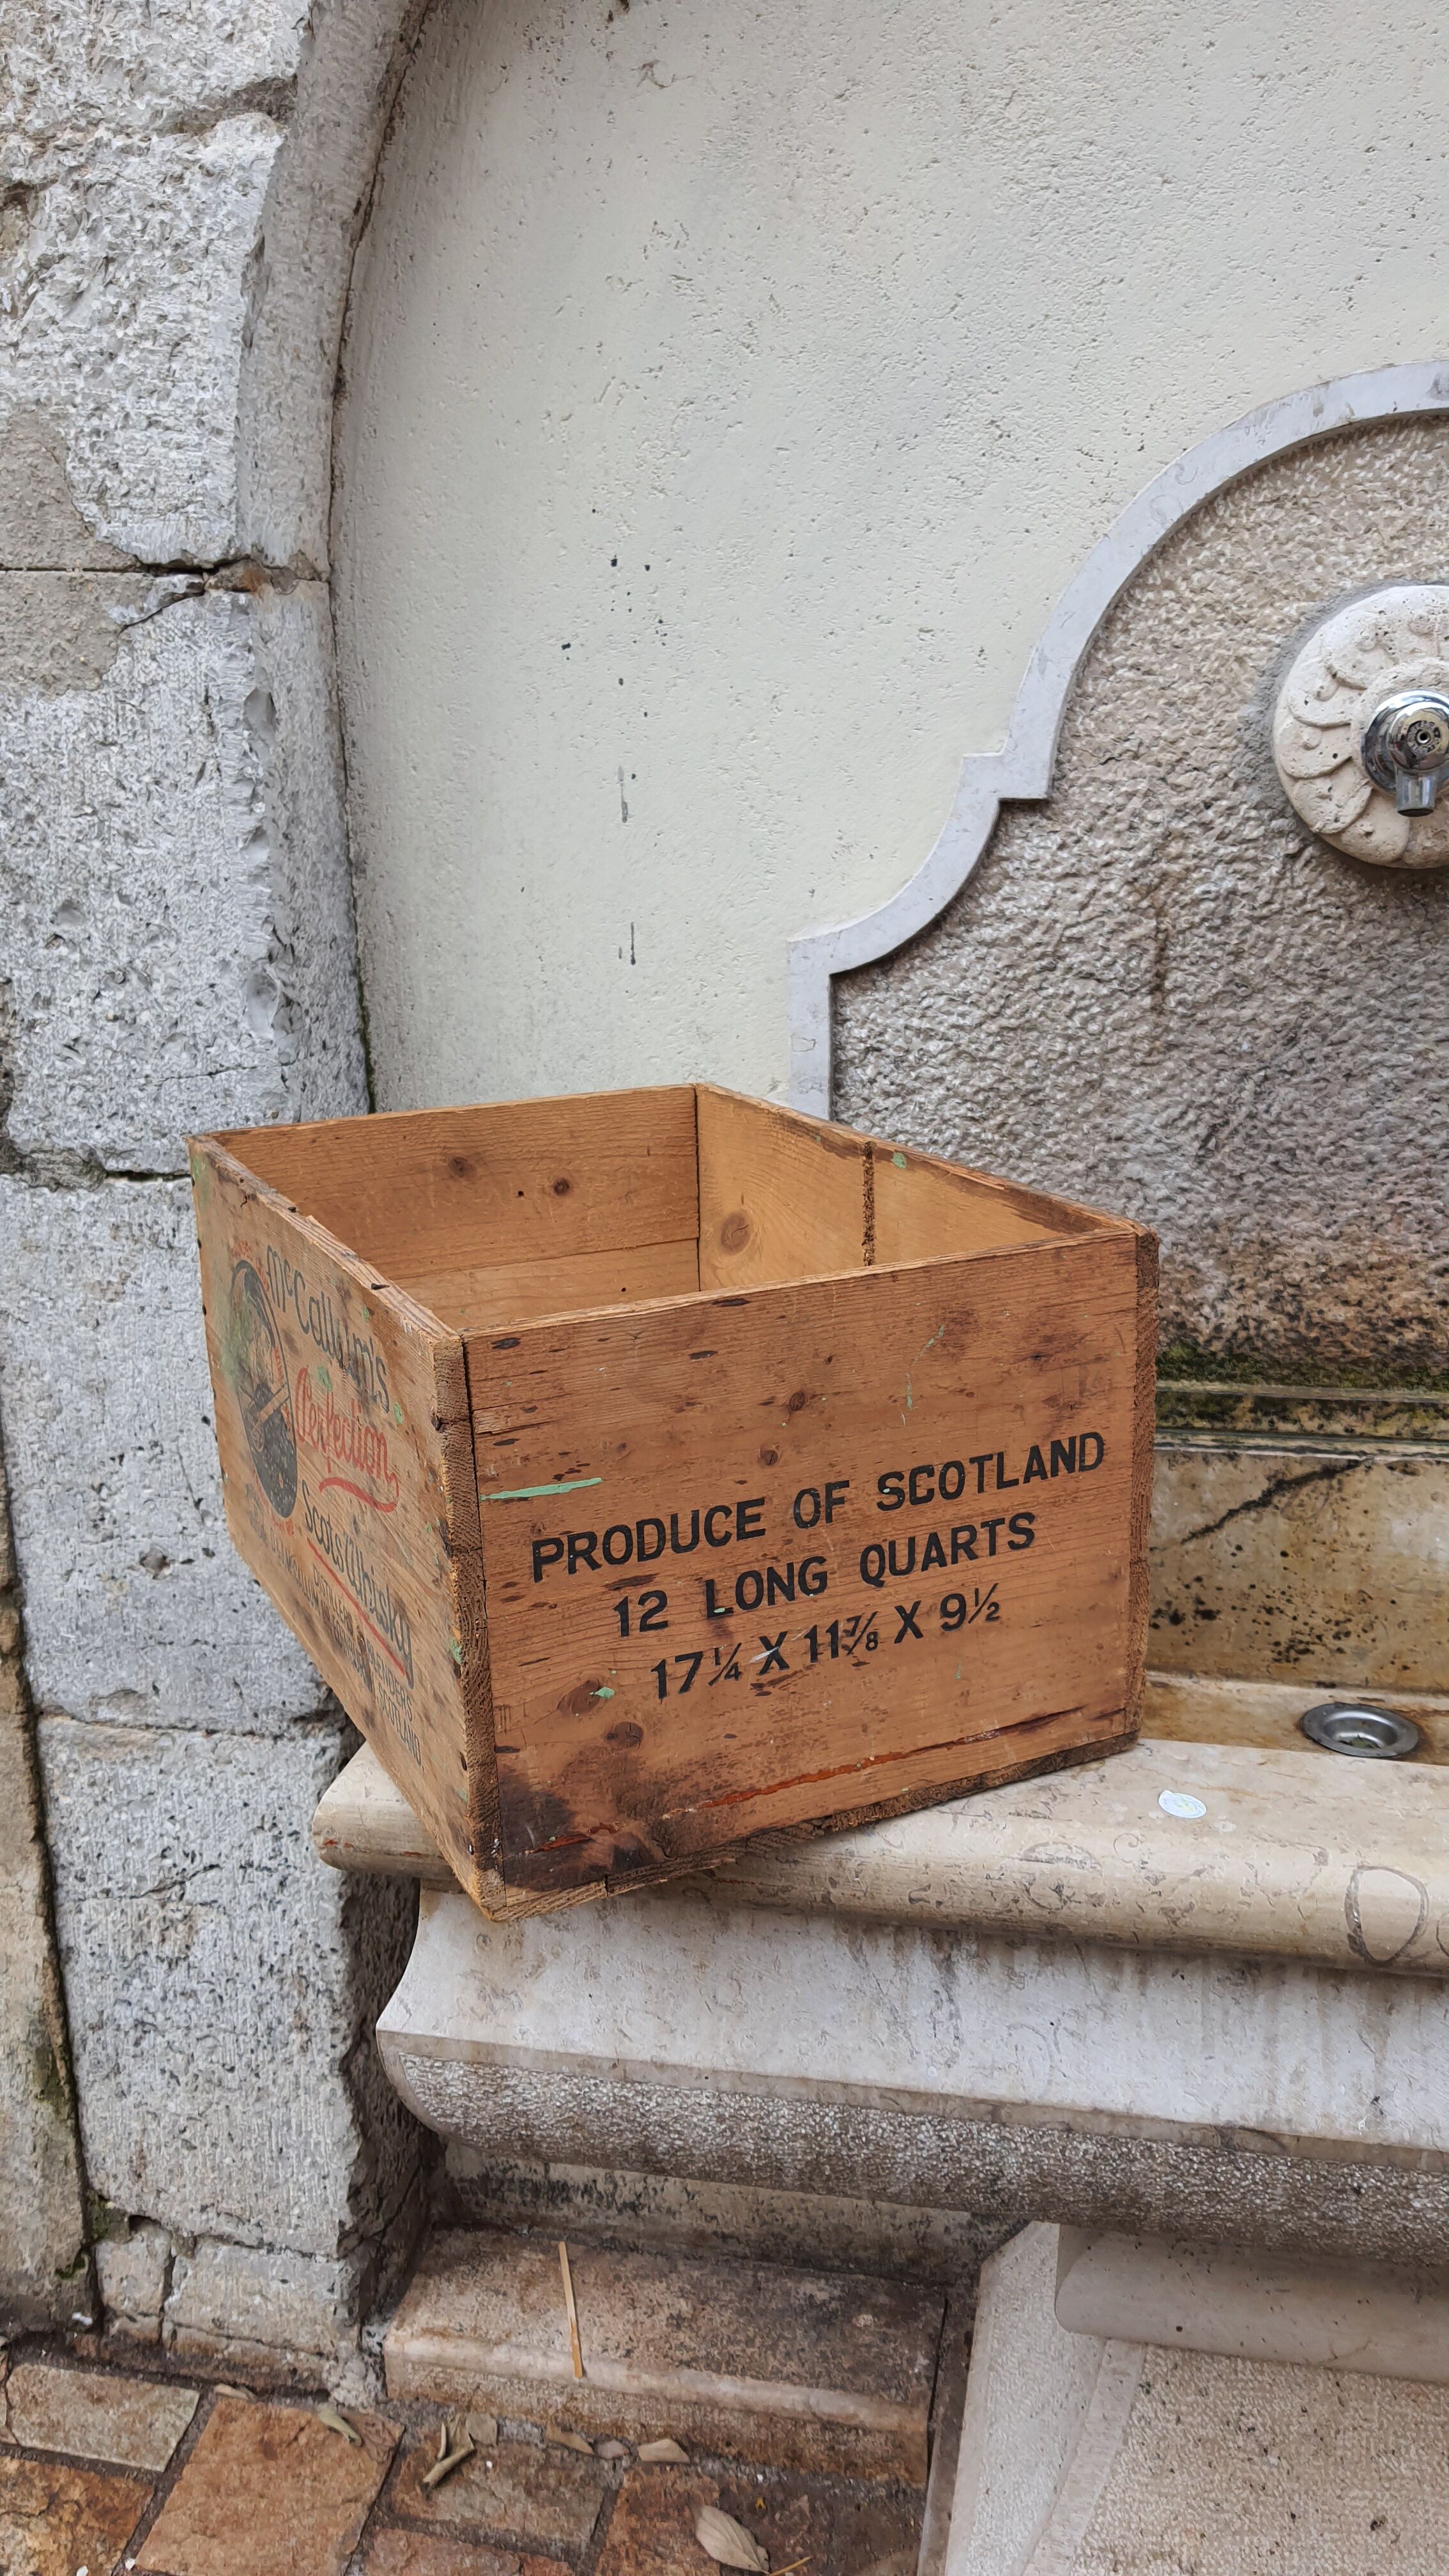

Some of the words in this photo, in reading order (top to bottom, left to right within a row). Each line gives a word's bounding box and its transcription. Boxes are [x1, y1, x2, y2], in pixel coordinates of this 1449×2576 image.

[295, 1366, 399, 1495] Perfection
[532, 1496, 766, 1584] PRODUCE
[793, 1480, 850, 1529] OF
[876, 1431, 1104, 1512] SCOTLAND
[613, 1590, 669, 1637] 12
[705, 1556, 828, 1620] LONG
[859, 1512, 1036, 1588] QUARTS
[302, 1478, 344, 1573] Scots
[344, 1531, 414, 1689] Whisky
[313, 1563, 353, 1637] DISTILLERS
[366, 1639, 413, 1722] BLENDERS
[894, 1600, 924, 1644] X
